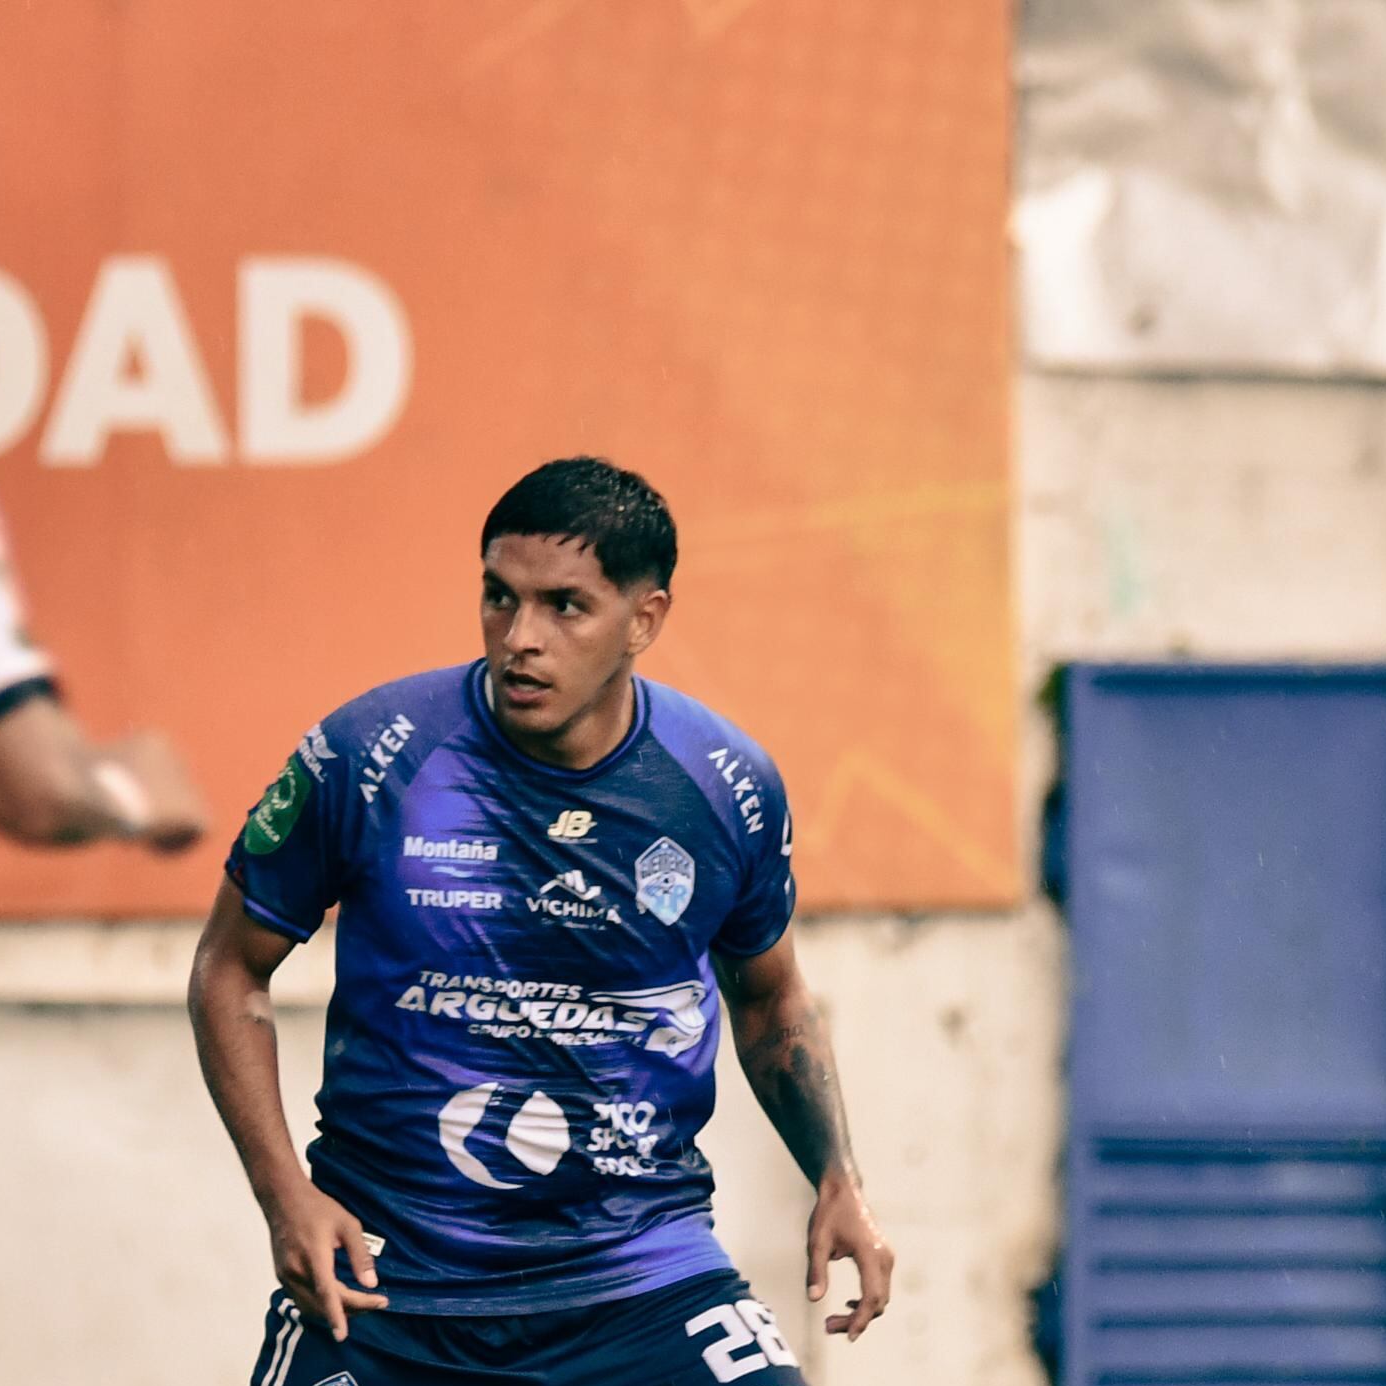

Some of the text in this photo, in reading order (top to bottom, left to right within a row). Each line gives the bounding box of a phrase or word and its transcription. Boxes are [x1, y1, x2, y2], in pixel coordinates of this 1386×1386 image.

[547, 810, 598, 838] JB
[403, 835, 499, 861] Montaña
[405, 888, 504, 911] TRUPER
[394, 985, 659, 1033] ARGUEDAS
